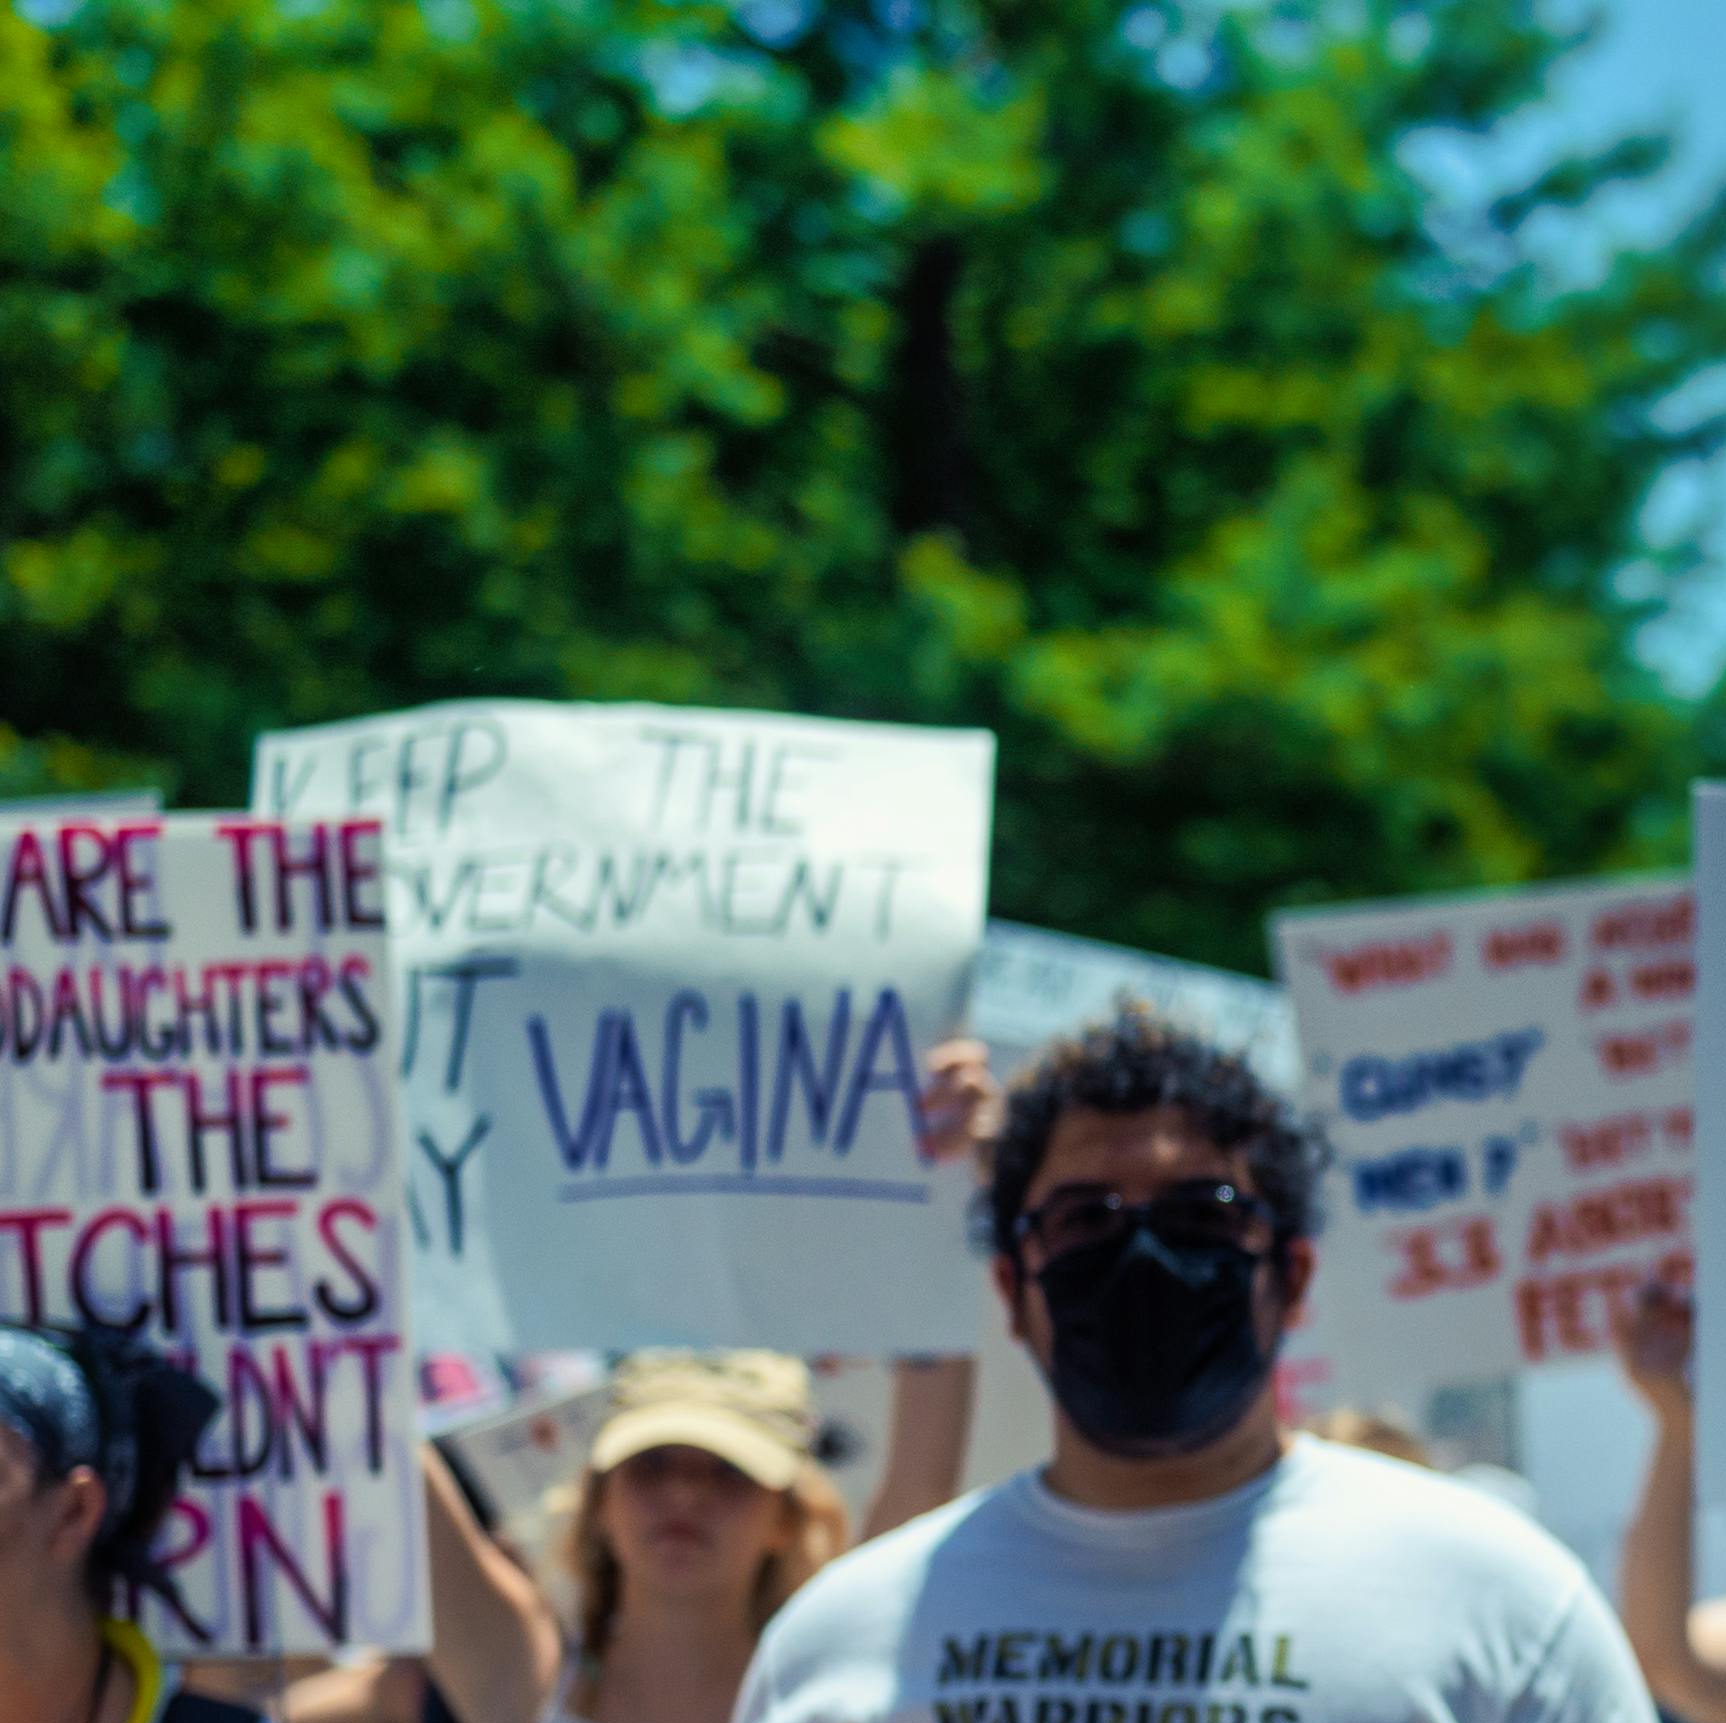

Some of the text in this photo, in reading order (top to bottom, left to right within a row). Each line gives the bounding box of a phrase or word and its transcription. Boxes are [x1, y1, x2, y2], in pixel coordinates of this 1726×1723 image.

[640, 724, 845, 840] THE
[2, 818, 387, 943] ARE THE
[99, 1066, 318, 1197] THE
[525, 982, 937, 1178] VAGINA
[0, 1199, 380, 1337] TCHES
[936, 1628, 1313, 1692] MEMORIAL
